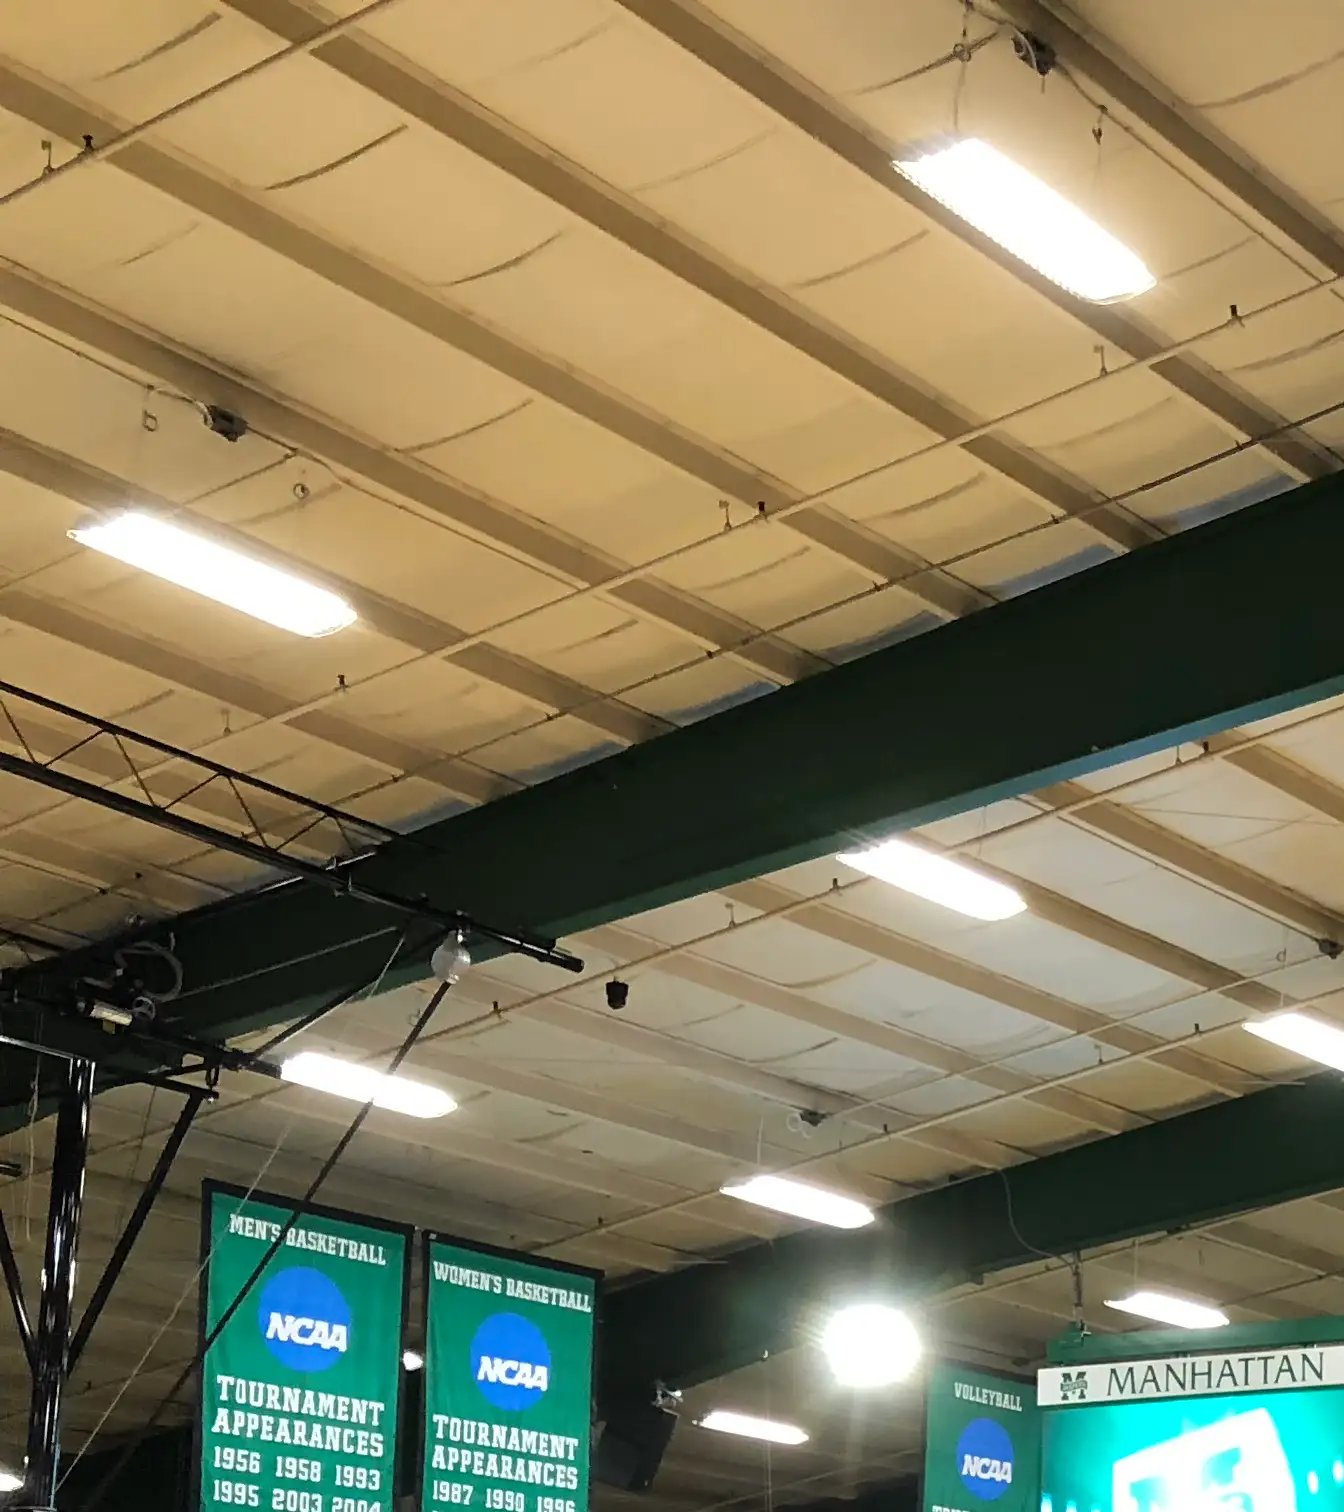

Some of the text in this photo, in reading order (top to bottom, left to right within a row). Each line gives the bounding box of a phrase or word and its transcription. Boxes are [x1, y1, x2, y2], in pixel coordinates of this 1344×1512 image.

[229, 1214, 386, 1265] MEN'S BASKETBALL
[433, 1262, 592, 1312] WOMEN'S BASKETBALL
[266, 1312, 347, 1352] NCAA
[477, 1356, 548, 1391] NCAA
[1106, 1352, 1325, 1397] MANHATTAN
[217, 1375, 384, 1427] TOURNAMENT
[954, 1382, 1022, 1412] VOLLEYBALL
[212, 1408, 384, 1457] APPEARANCES
[433, 1415, 579, 1460] TOURNAMENT
[213, 1446, 381, 1490] 1956 1958 1993
[432, 1446, 578, 1490] APPEARANCES
[961, 1454, 1012, 1484] NCAA
[213, 1480, 259, 1506] 1995
[433, 1480, 473, 1505] 1987
[485, 1489, 524, 1512] 1990
